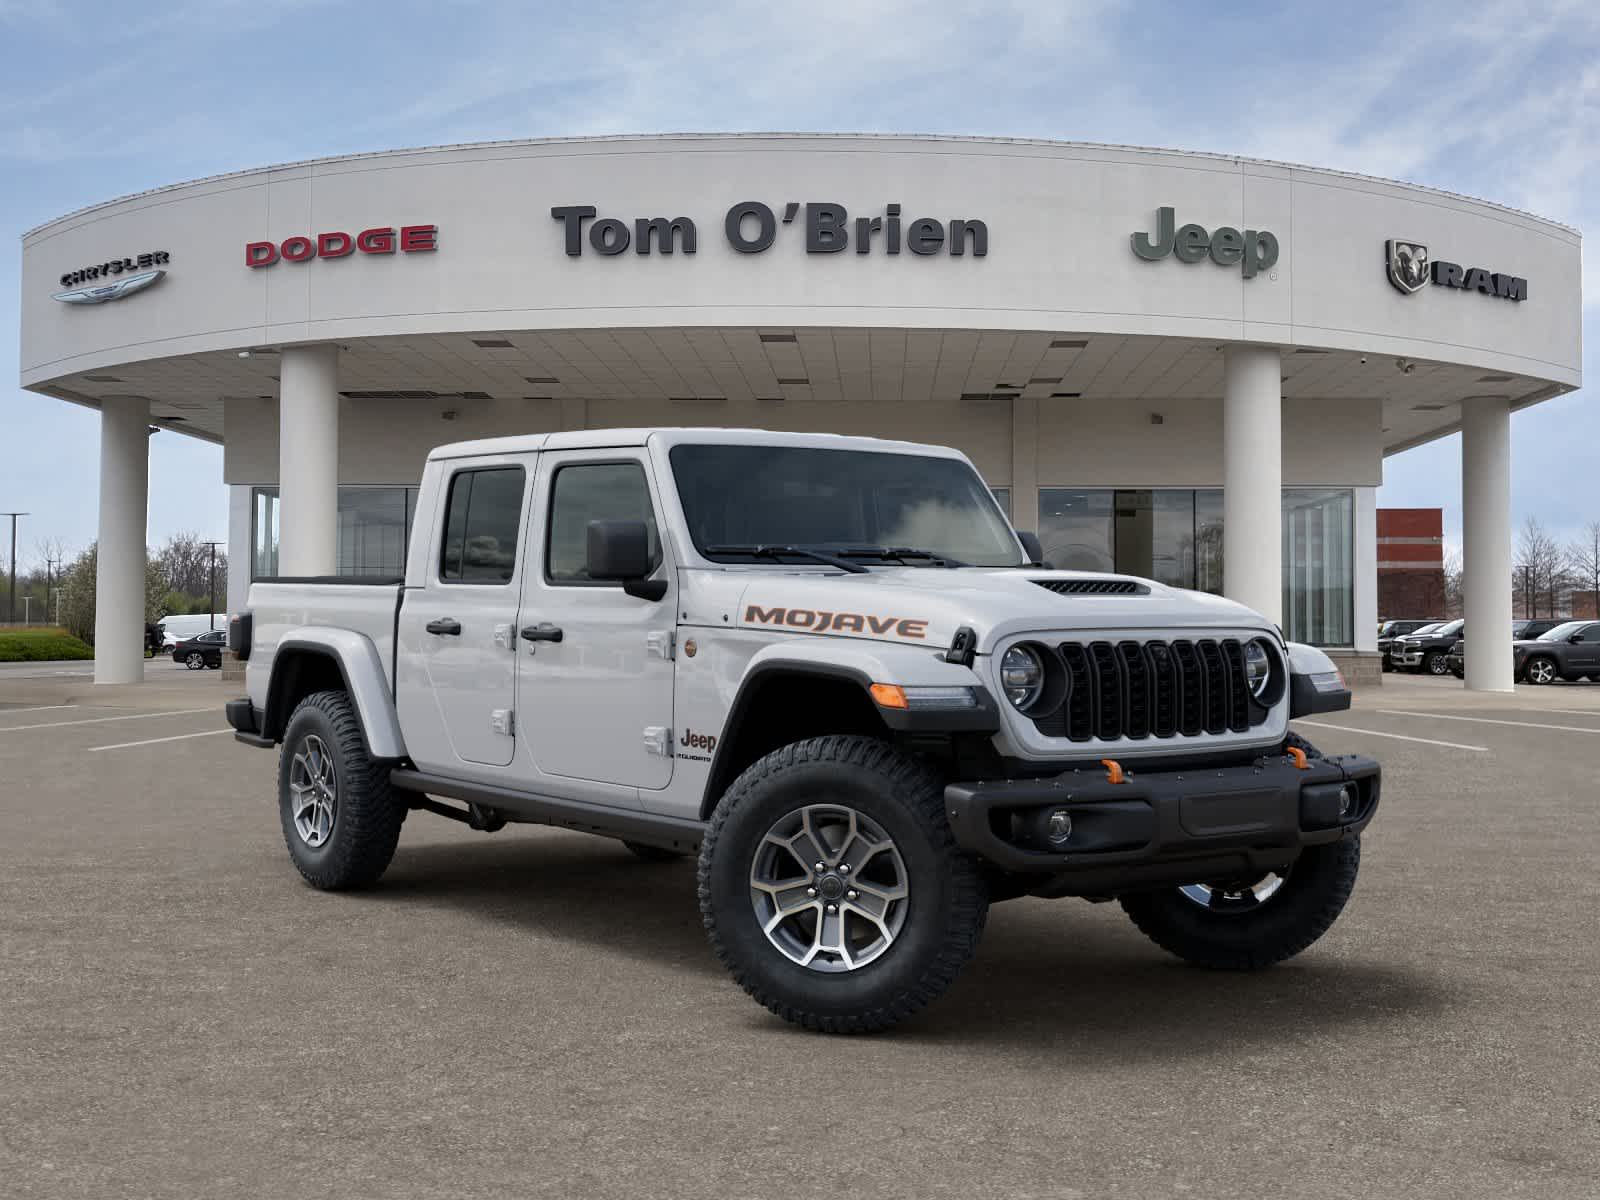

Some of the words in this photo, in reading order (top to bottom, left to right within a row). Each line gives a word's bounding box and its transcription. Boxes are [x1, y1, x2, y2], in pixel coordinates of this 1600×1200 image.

[246, 225, 438, 269] DODGE
[551, 205, 697, 256] Tom
[725, 201, 988, 256] O'Brien
[1130, 207, 1279, 279] Jeep
[60, 249, 170, 287] CHRYSLER
[1431, 260, 1528, 301] RAM
[745, 605, 929, 638] MOJAVE
[680, 728, 717, 753] Jeep
